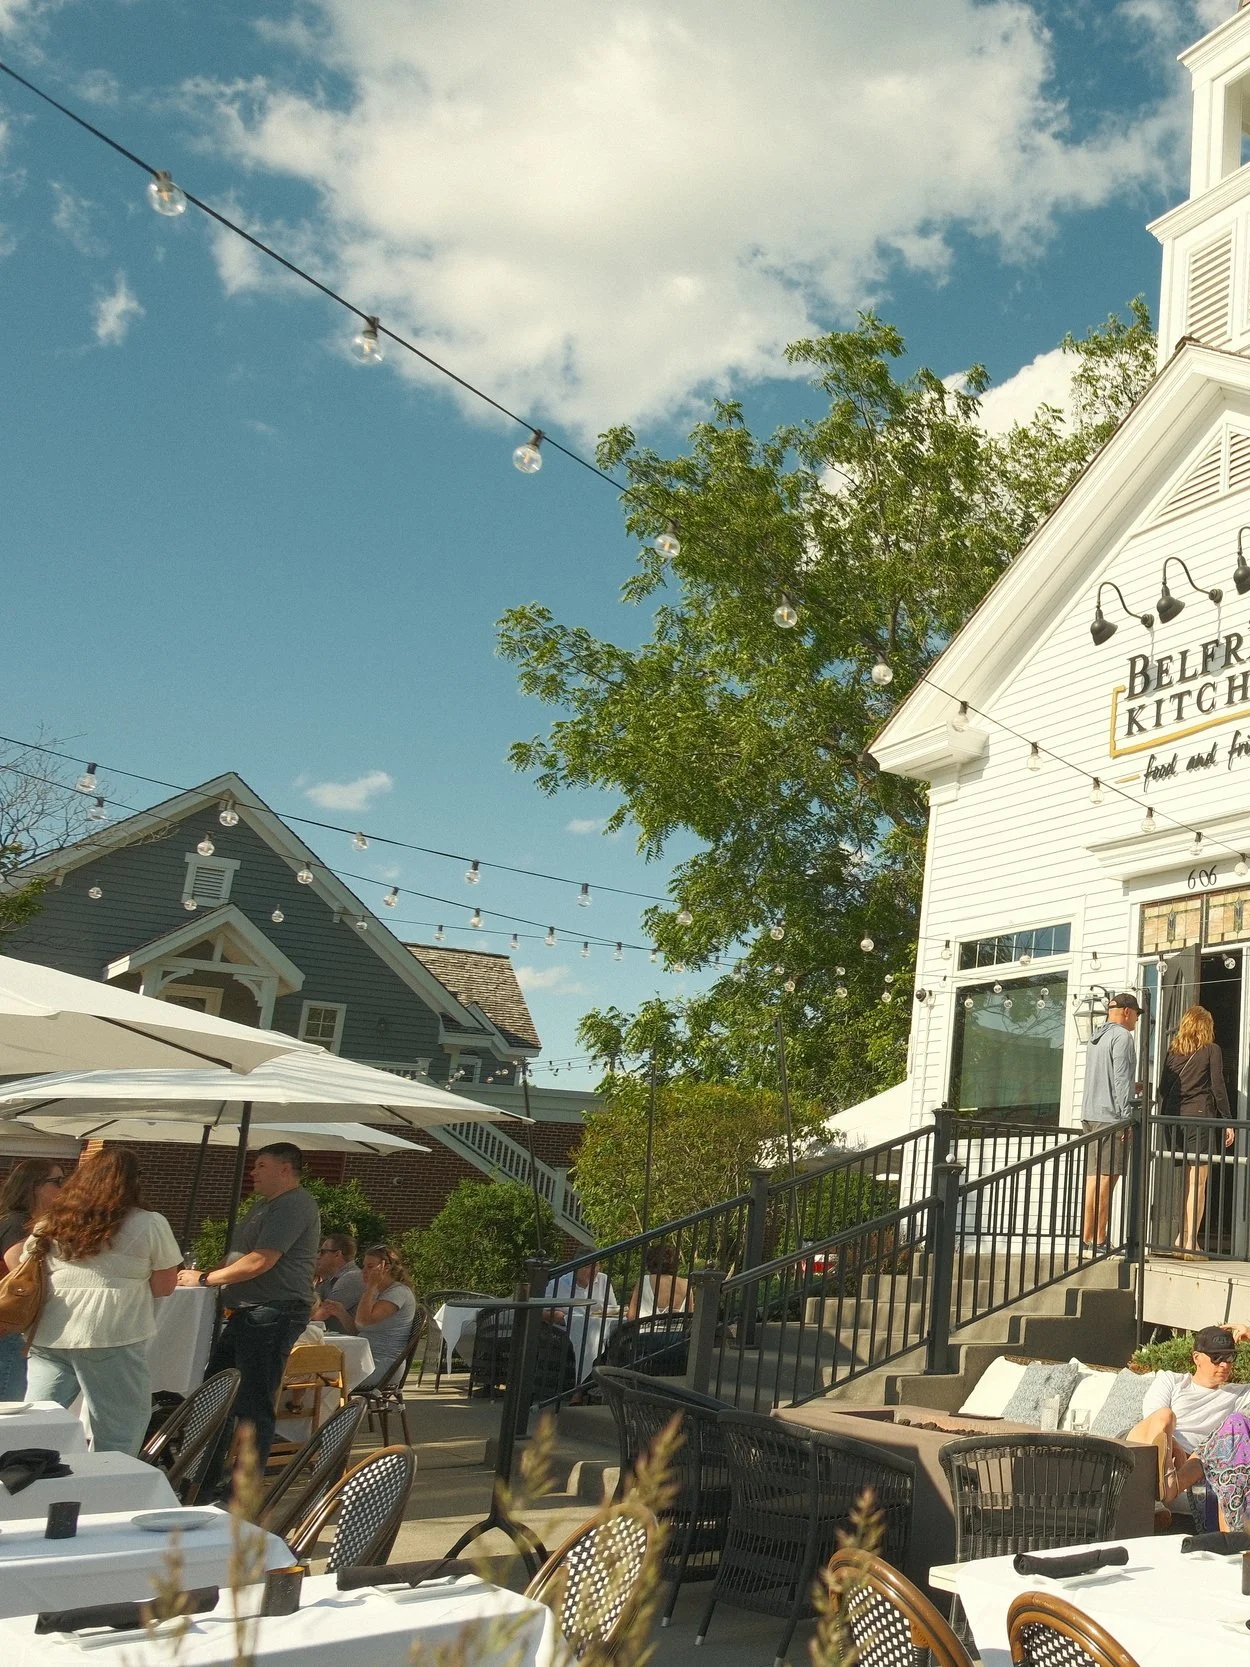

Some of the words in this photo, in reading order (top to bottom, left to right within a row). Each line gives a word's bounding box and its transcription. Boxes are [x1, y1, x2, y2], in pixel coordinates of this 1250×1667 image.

[1143, 753, 1179, 793] food
[1186, 741, 1218, 773] and
[1187, 864, 1217, 890] 606
